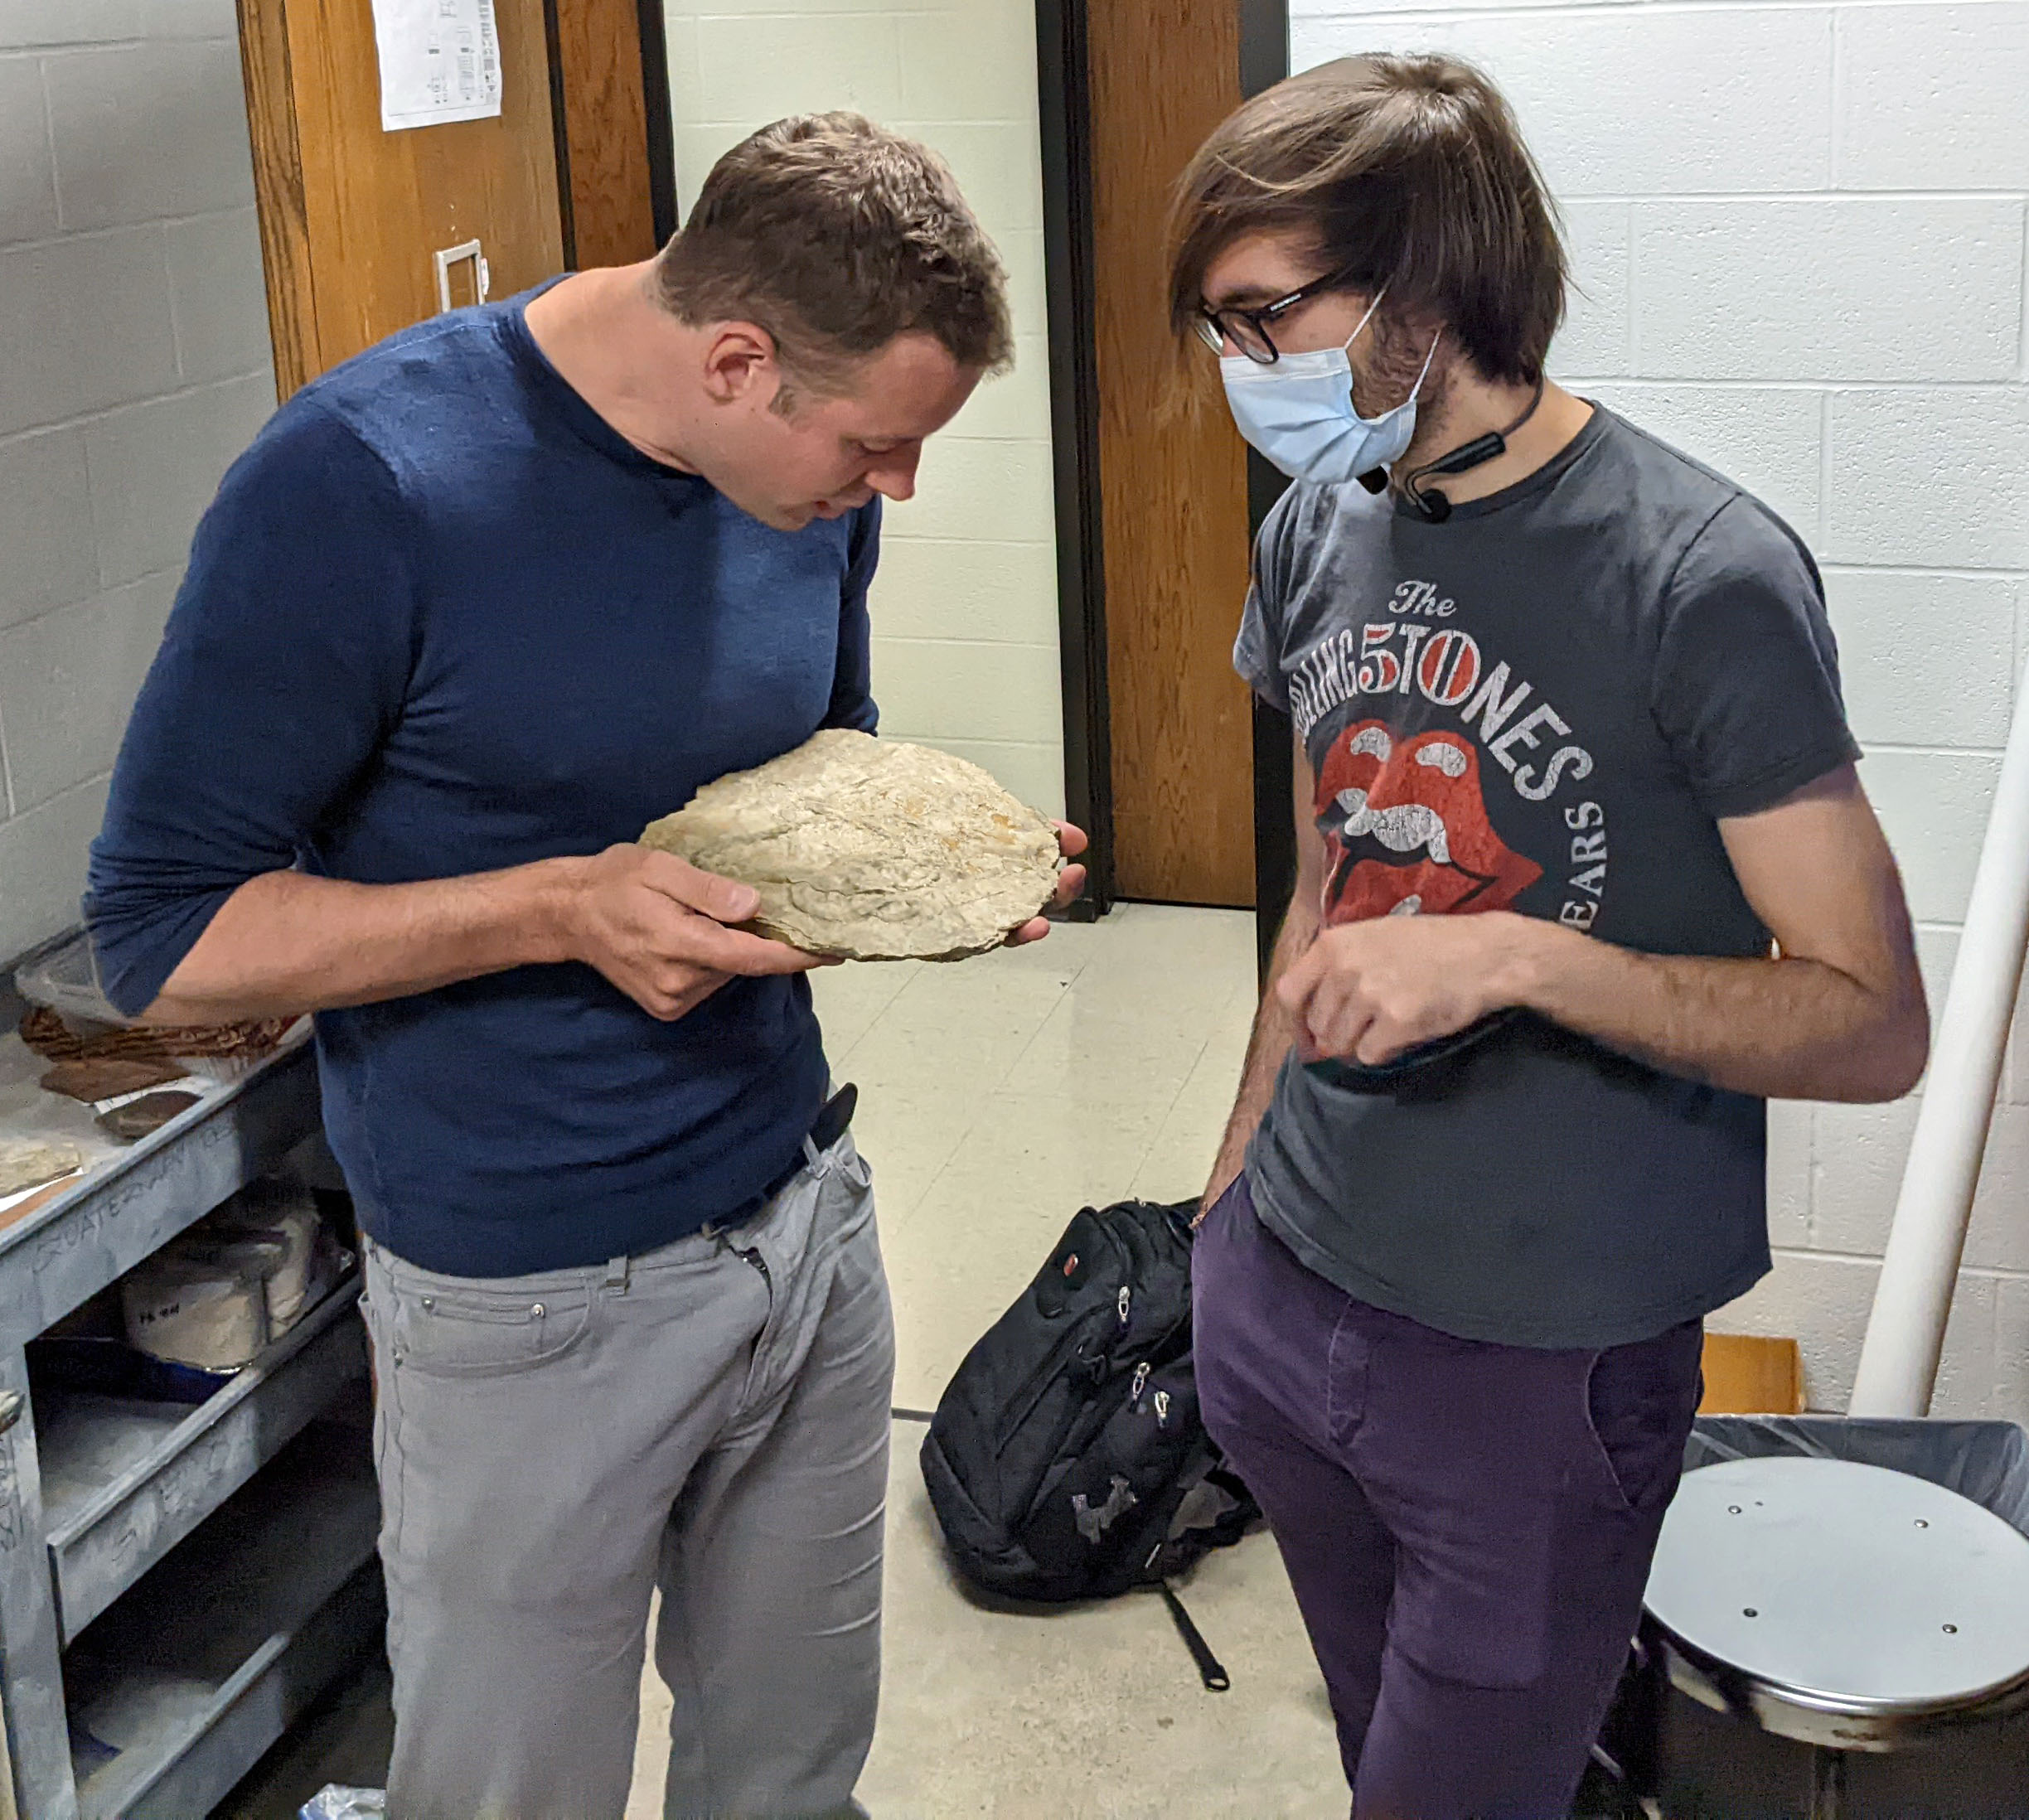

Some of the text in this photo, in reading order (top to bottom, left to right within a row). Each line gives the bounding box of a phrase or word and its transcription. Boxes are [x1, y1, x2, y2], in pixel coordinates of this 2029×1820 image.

[1387, 579, 1458, 617] The
[1288, 628, 1358, 745] OLLING
[1558, 801, 1609, 930] EARS
